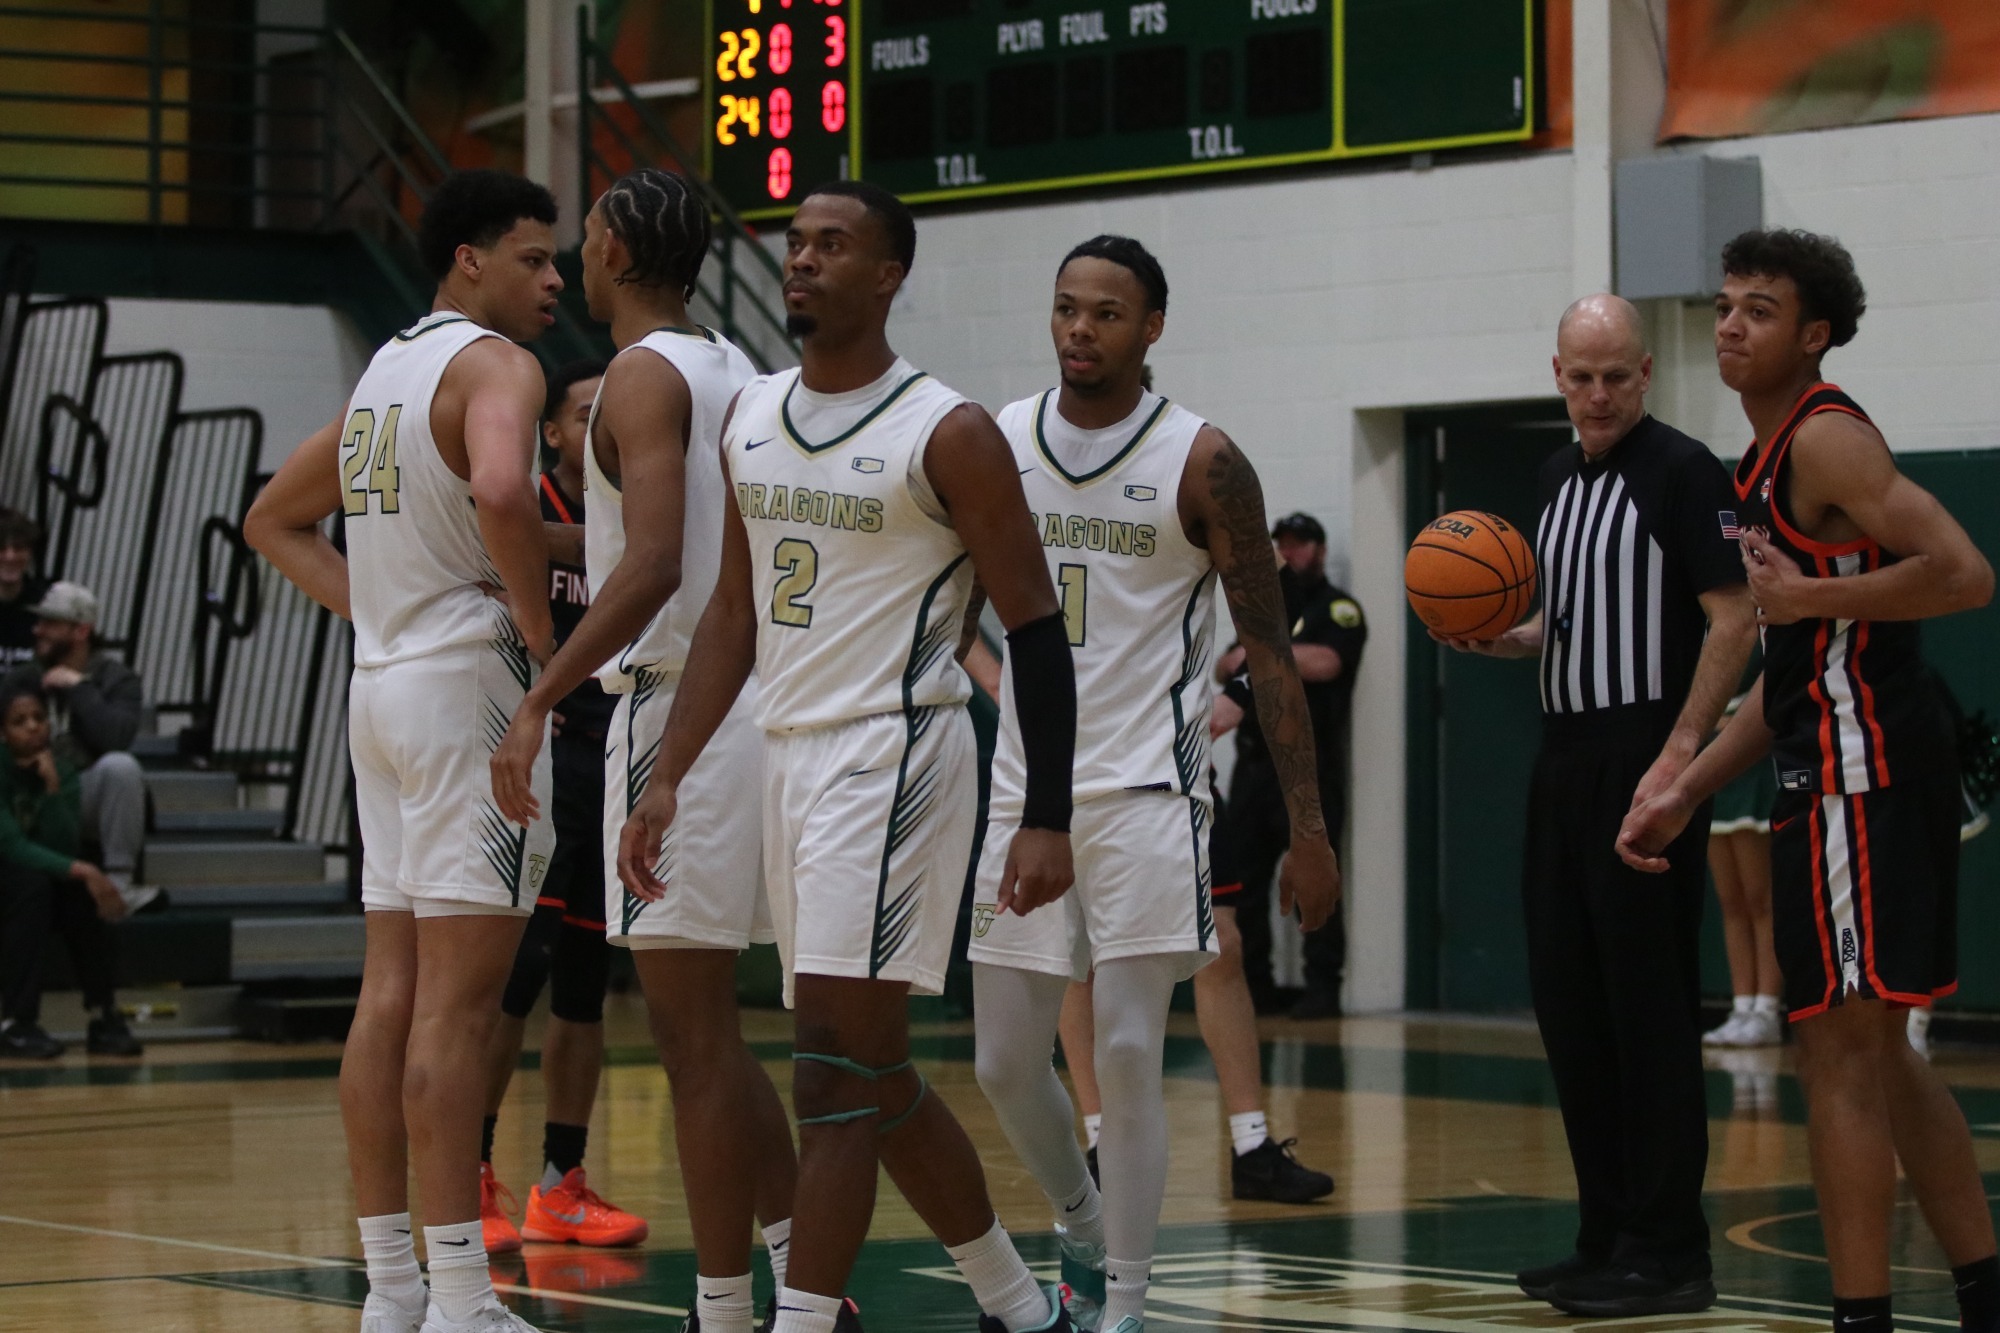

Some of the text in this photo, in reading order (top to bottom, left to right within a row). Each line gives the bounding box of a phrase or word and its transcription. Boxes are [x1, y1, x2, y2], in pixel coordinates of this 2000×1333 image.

[717, 15, 845, 81] 22 0 3
[872, 35, 930, 71] FOULS
[998, 2, 1168, 54] PLYR FOUL PTS
[717, 80, 845, 145] 24 0 0
[768, 147, 791, 199] 0
[342, 403, 403, 518] 24
[737, 482, 883, 533] DRAGONS
[771, 537, 818, 629] 2
[1058, 563, 1087, 647] 1
